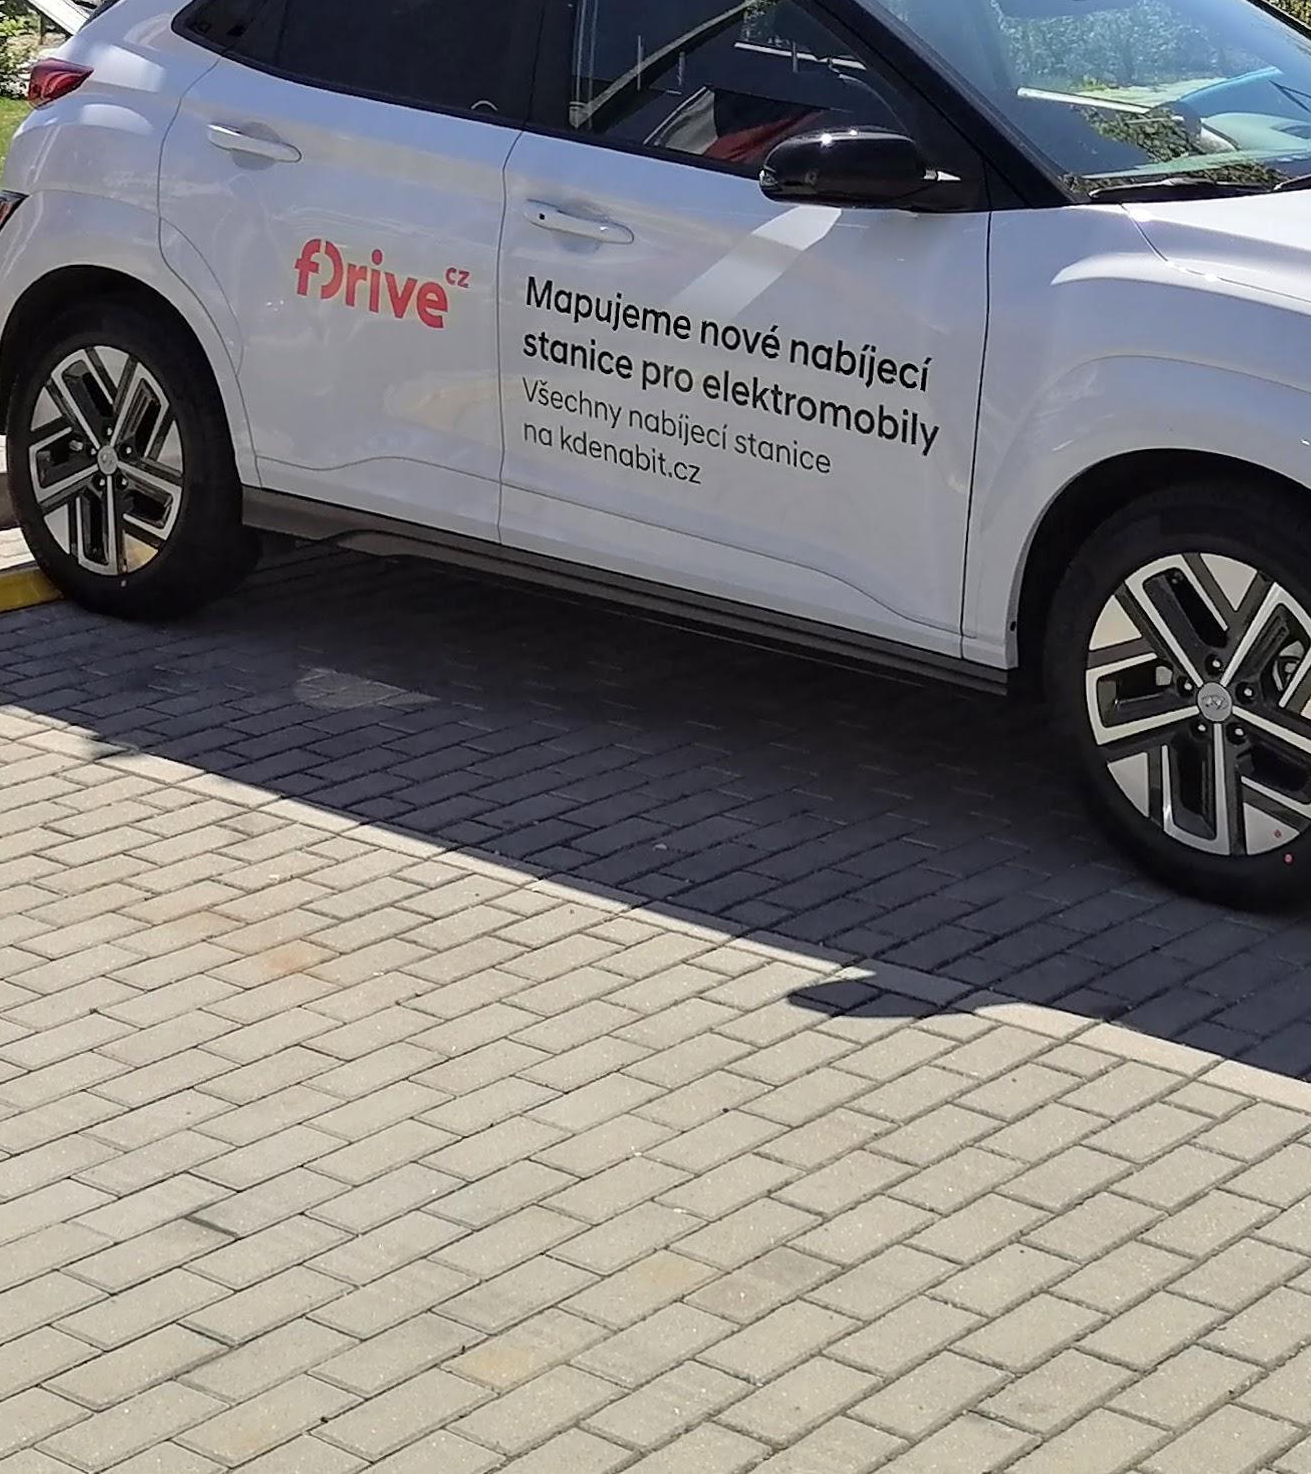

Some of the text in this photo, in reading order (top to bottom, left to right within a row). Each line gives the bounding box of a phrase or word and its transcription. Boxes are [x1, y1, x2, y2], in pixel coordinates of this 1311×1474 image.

[525, 276, 933, 392] Mapujeme nové nabíjecí
[522, 376, 832, 474] Všechny nabíjecí stanice
[523, 331, 940, 457] stanice pro elektromobily
[523, 422, 702, 485] na kdenabit.cz
